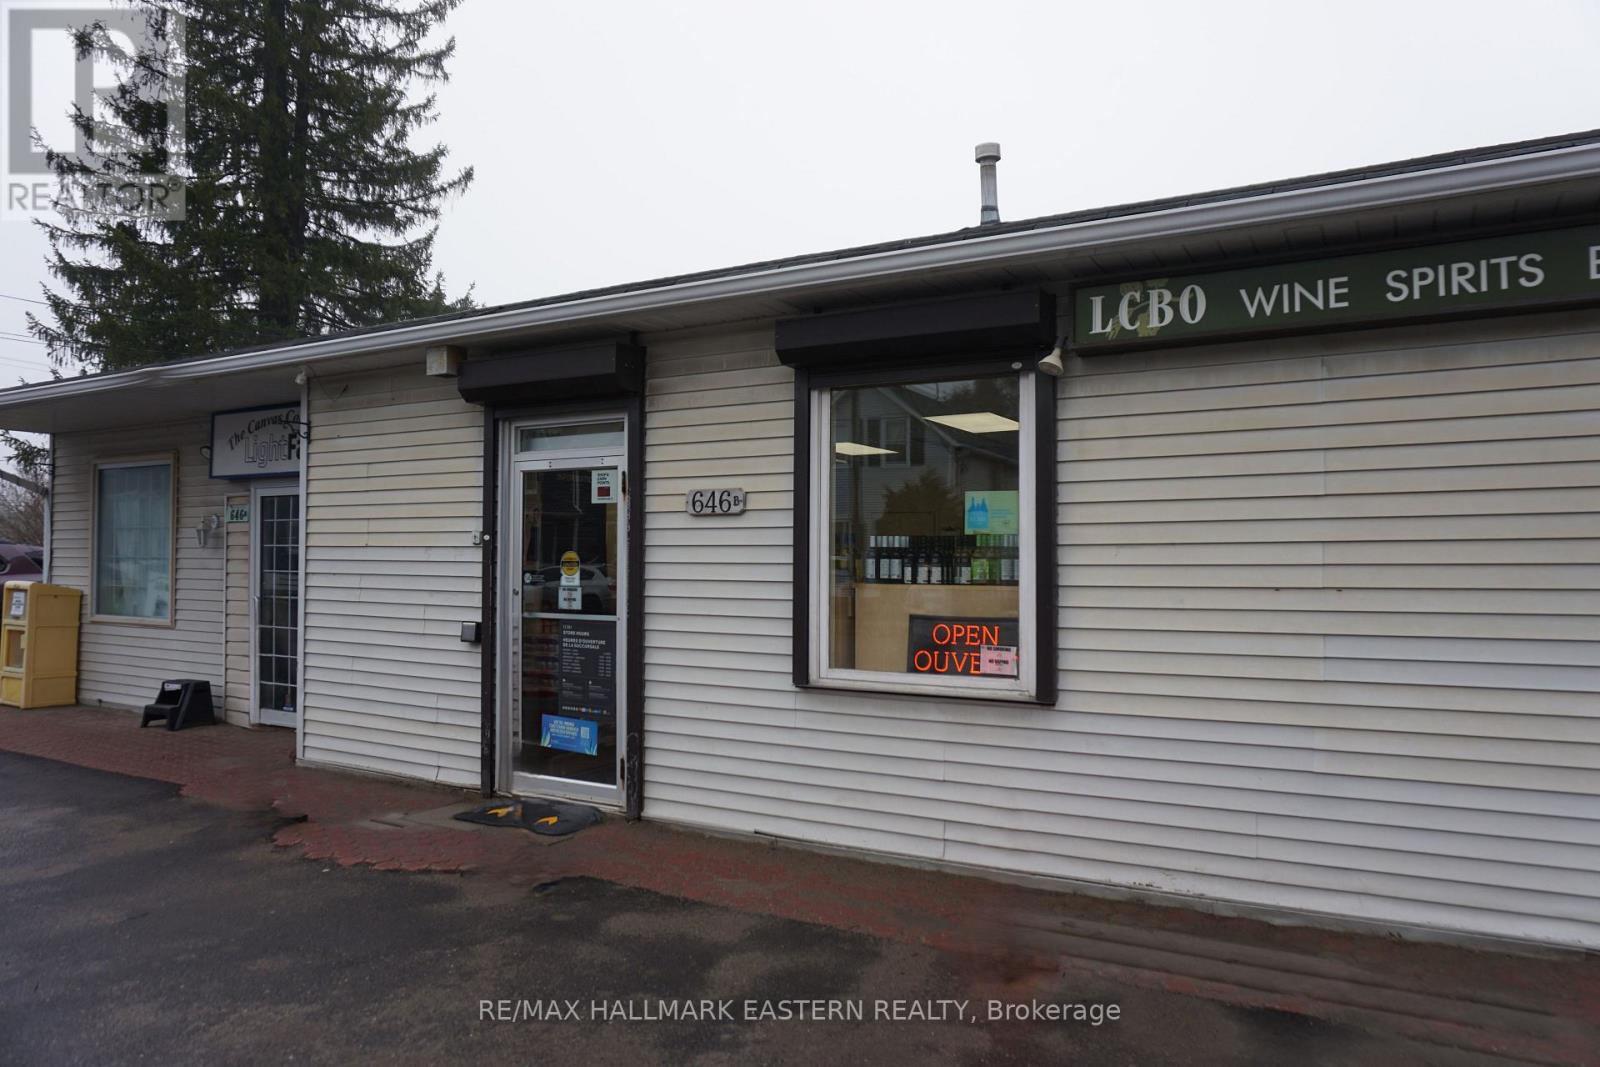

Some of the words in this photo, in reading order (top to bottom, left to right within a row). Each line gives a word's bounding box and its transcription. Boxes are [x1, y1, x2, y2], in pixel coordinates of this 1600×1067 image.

[1089, 284, 1207, 335] LCBO
[1239, 275, 1350, 319] WINE
[1385, 252, 1545, 303] SPIRITS
[227, 429, 245, 451] The
[932, 623, 999, 646] OPEN
[914, 650, 981, 675] OUVE
